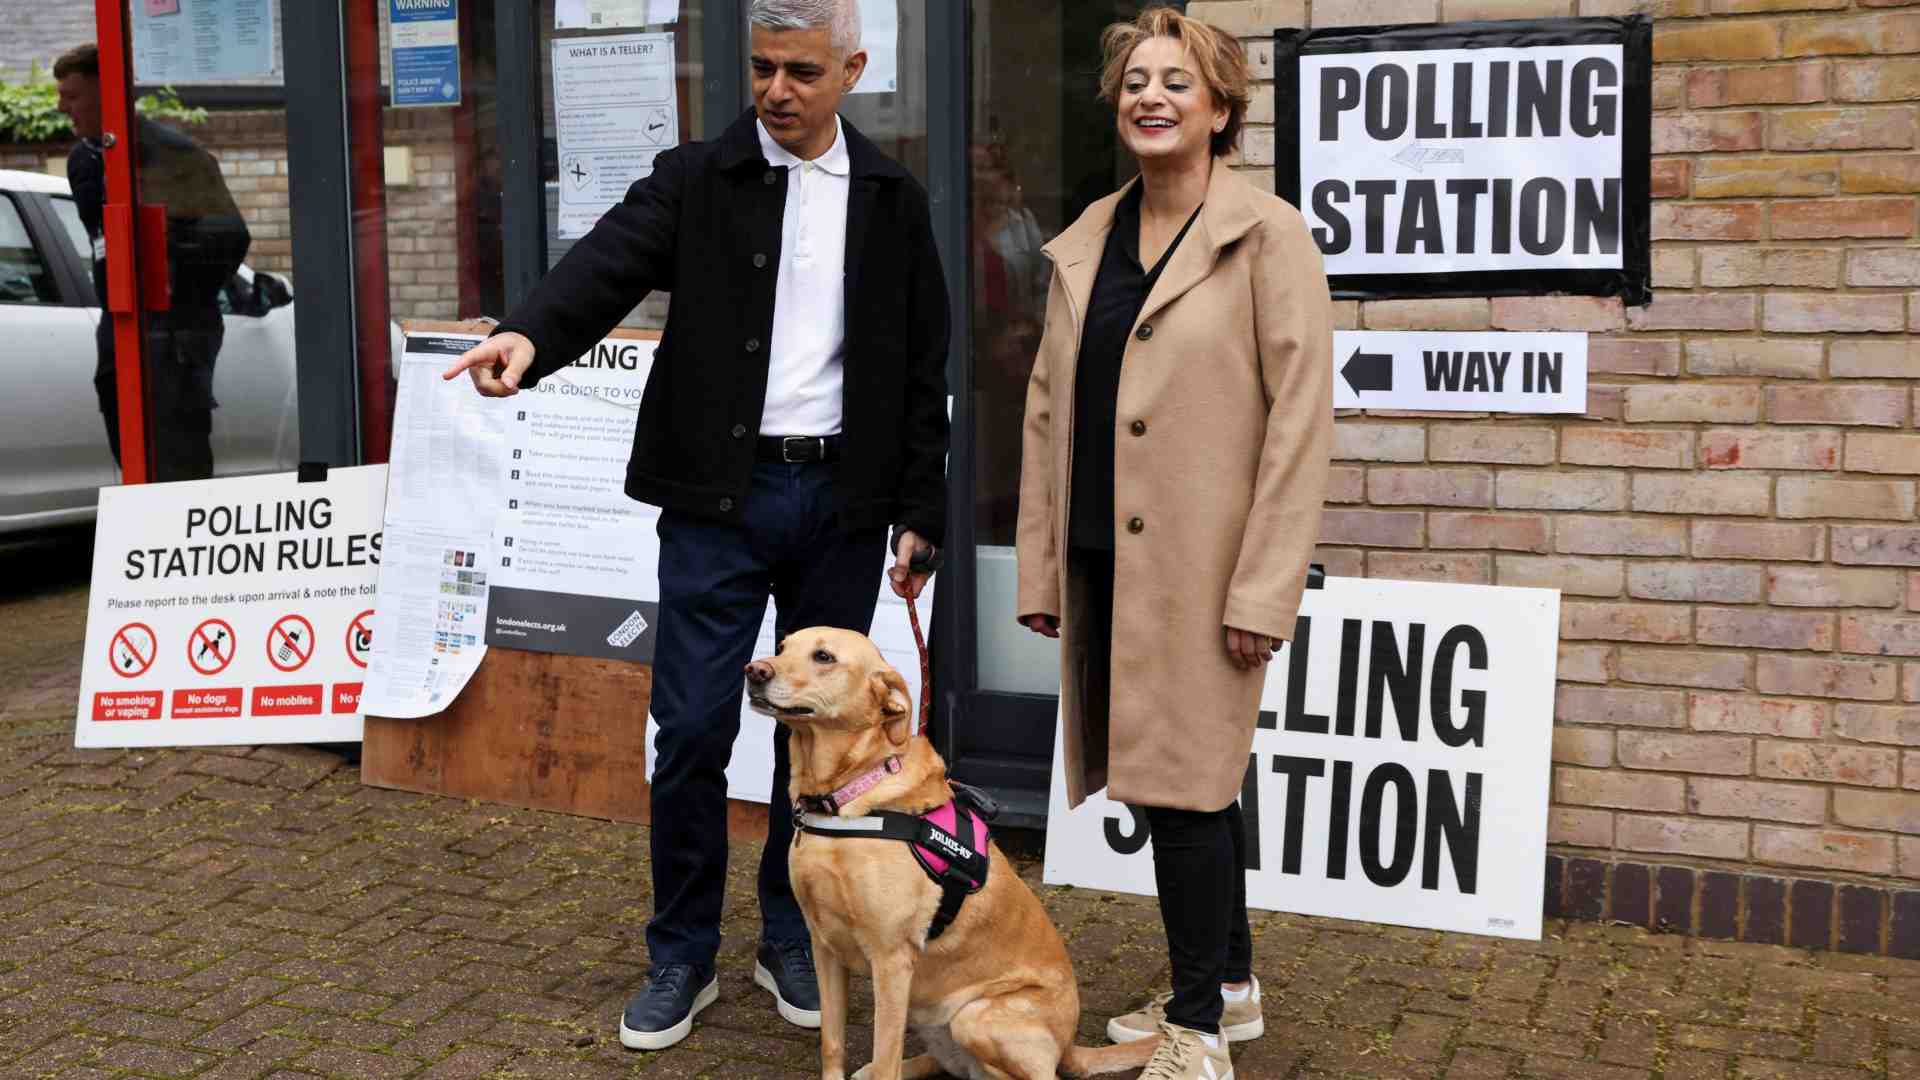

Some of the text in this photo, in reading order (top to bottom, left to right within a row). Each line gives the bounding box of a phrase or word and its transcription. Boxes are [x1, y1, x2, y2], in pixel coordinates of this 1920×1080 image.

[569, 44, 654, 57] WHAT IS A TELLER?
[1318, 56, 1619, 141] POLLING
[1311, 176, 1621, 256] STATION
[1422, 350, 1563, 394] WAY IN
[604, 386, 621, 398] TO
[187, 497, 332, 538] POLLING
[125, 532, 383, 580] STATION RULES
[107, 597, 142, 608] Please
[144, 597, 176, 610] report
[179, 597, 188, 605] to
[192, 594, 208, 605] the
[210, 593, 236, 604] desk
[239, 593, 264, 604] upon
[267, 589, 300, 601] arrival
[303, 588, 310, 598] &
[314, 588, 337, 598] note
[340, 585, 356, 596] the
[611, 614, 640, 644] LONDON
[1257, 616, 1488, 748] LING
[100, 696, 156, 708] No smoking
[187, 693, 227, 706] No dogs
[260, 695, 314, 707] No mobiles
[339, 693, 353, 704] No
[105, 707, 149, 718] or vaping
